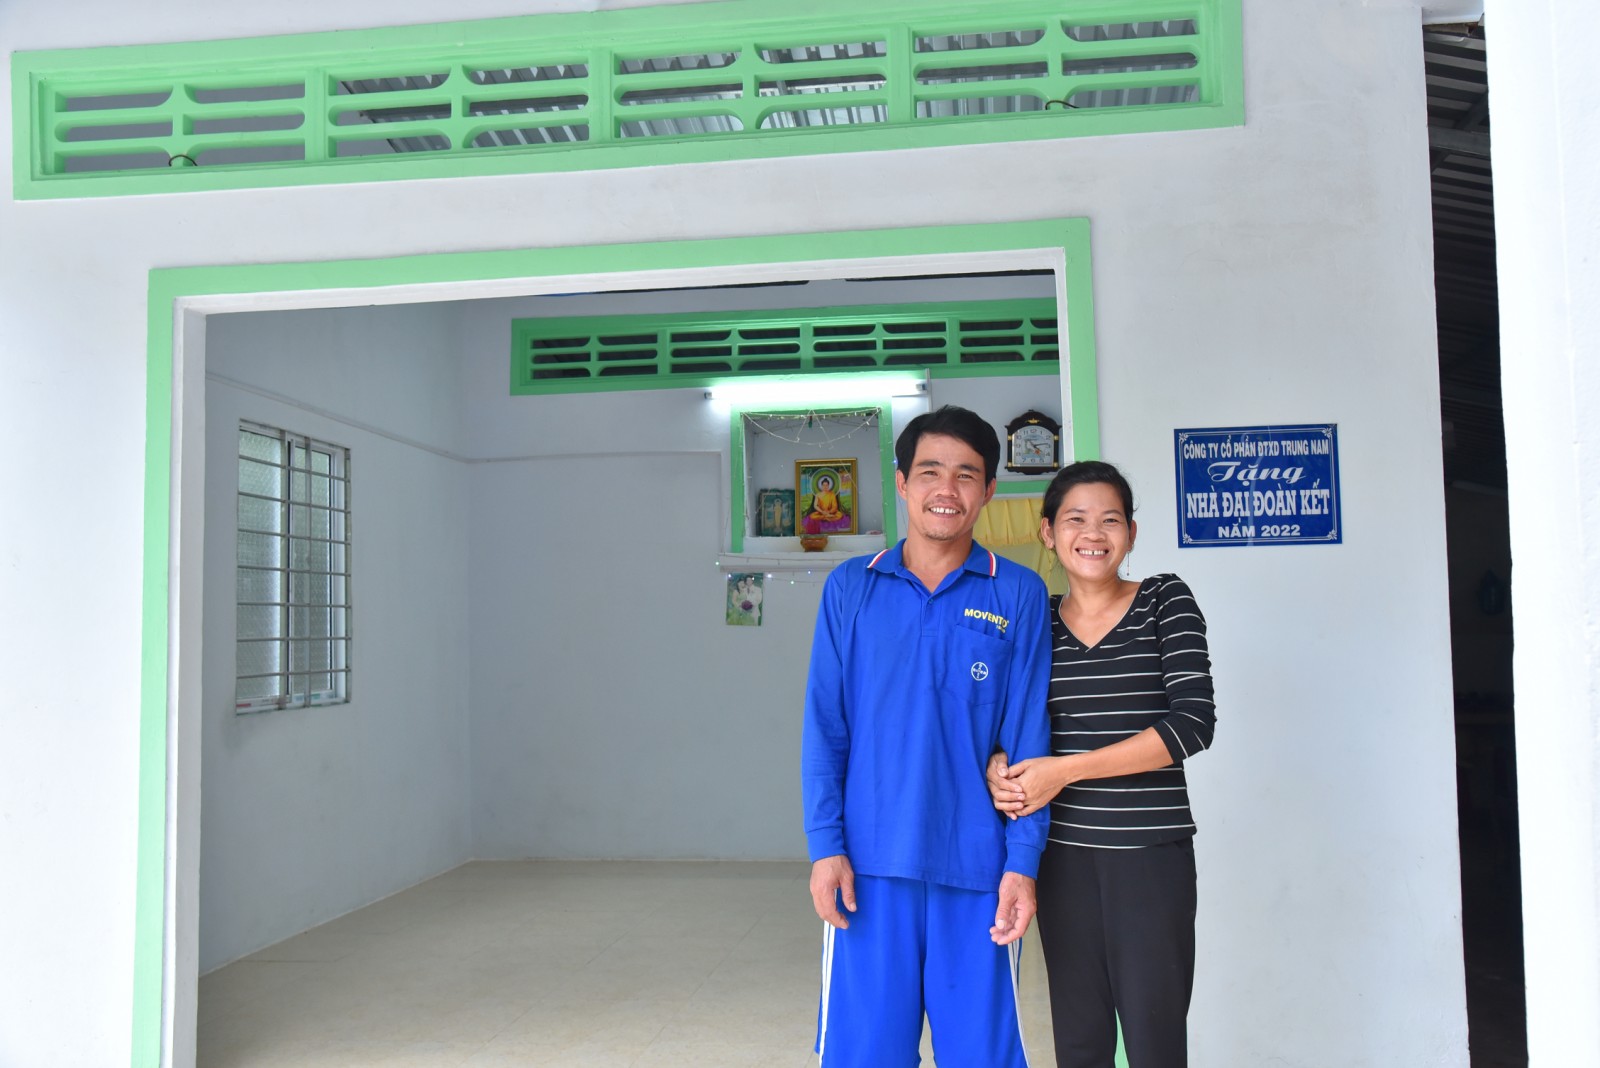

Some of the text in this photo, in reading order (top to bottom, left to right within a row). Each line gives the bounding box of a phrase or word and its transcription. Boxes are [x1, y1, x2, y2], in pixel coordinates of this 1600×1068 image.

[1184, 440, 1206, 459] CÔNG
[1208, 443, 1218, 458] TY
[1221, 435, 1232, 458] CỔ
[1258, 441, 1279, 456] ĐTXD
[1281, 440, 1309, 456] TRUNG
[1311, 439, 1329, 455] NAM
[1207, 461, 1306, 486] Tặng
[1186, 478, 1330, 522] NHÀ ĐẠI ĐOÀN KẾT
[1218, 523, 1301, 538] NĂM 2022
